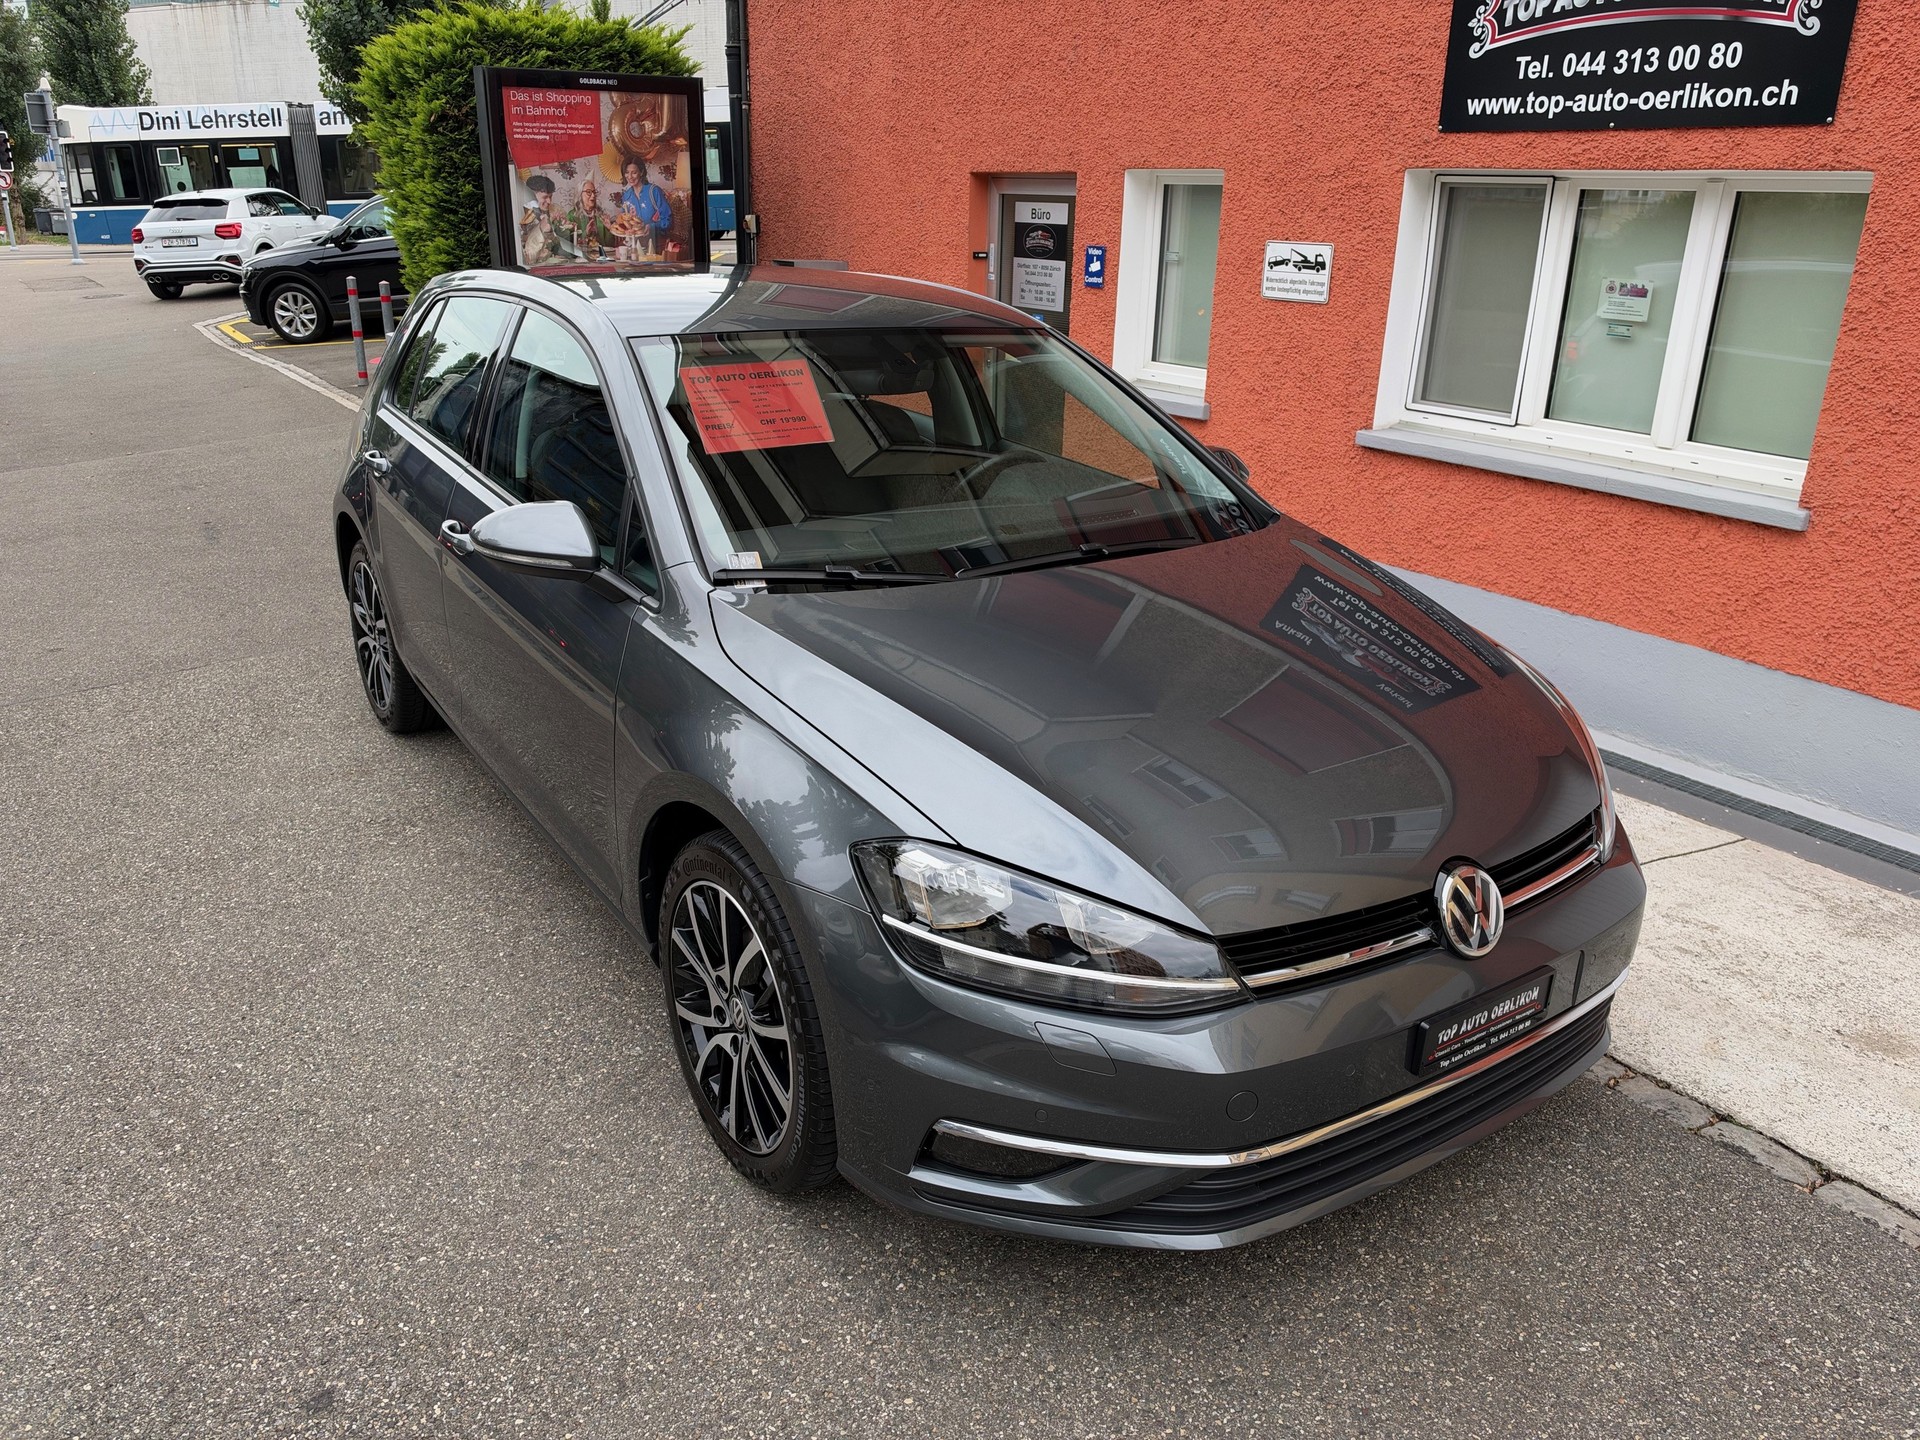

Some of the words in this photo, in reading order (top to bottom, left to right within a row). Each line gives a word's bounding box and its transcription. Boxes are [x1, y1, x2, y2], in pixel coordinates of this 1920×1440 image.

[1516, 56, 1554, 80] Tel.
[1562, 52, 1605, 78] 044
[1613, 47, 1659, 75] 313
[1668, 44, 1700, 71] 00
[1708, 42, 1742, 69] 80
[510, 90, 530, 100] Das
[532, 92, 544, 102] ist
[546, 92, 592, 106] Shopping
[1466, 79, 1799, 118] www.top-auto-oerlikon.ch
[512, 105, 523, 114] im
[526, 105, 568, 116] Bahnhof.
[138, 111, 180, 131] Dini
[187, 108, 282, 129] Lehrstell
[1031, 208, 1051, 220] Büro
[688, 376, 712, 384] TOP
[716, 373, 746, 383] AUTO
[749, 368, 804, 380] OERLIKON
[705, 422, 734, 431] PREIS:
[780, 415, 807, 424] 19'990
[682, 854, 726, 882] Continental
[1438, 1023, 1458, 1044] TOP
[1459, 1010, 1488, 1035] AUTO
[1491, 986, 1540, 1020] OERLIKON
